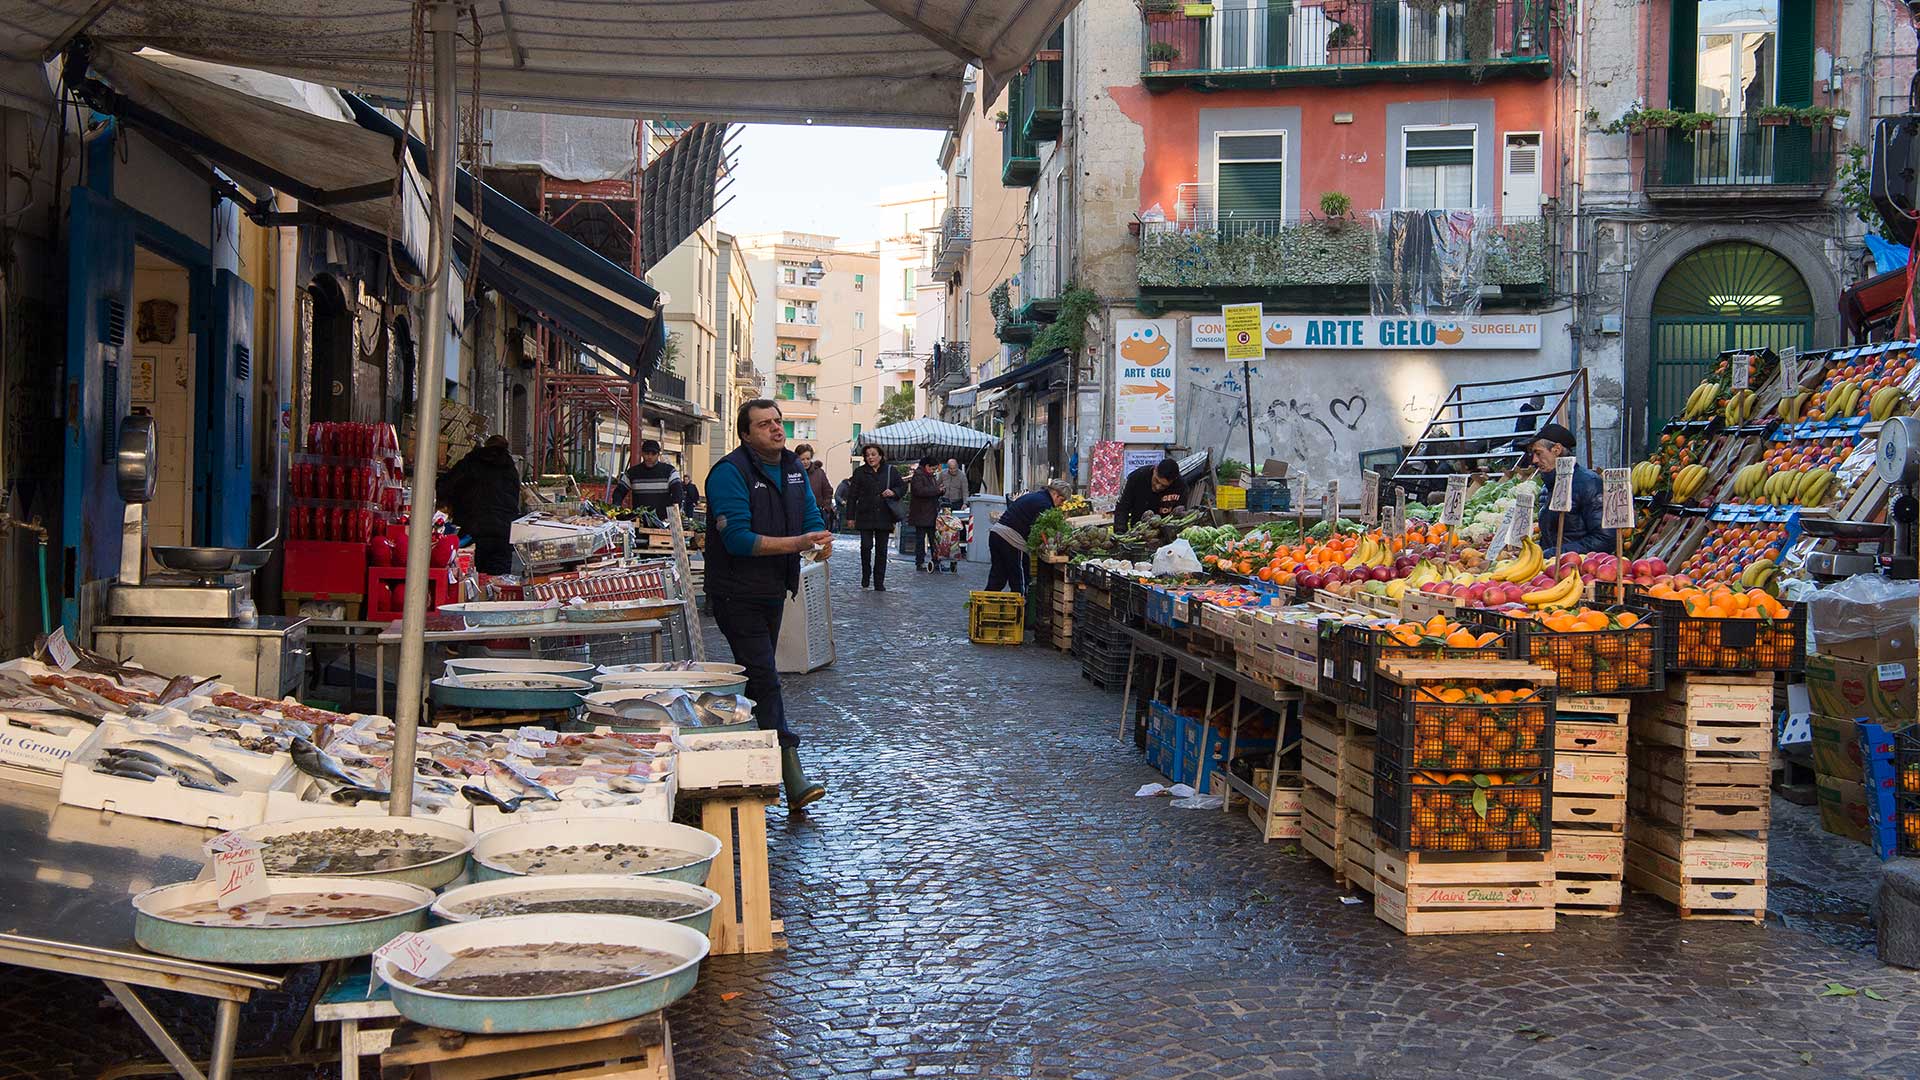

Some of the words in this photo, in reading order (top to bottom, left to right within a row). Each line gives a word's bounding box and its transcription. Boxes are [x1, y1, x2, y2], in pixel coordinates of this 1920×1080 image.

[1197, 324, 1224, 334] CON
[1305, 320, 1363, 346] ARTE
[1379, 320, 1437, 346] GELO
[1471, 323, 1537, 334] SURGELATI
[1124, 367, 1146, 378] ARTE
[1150, 367, 1171, 378] GELO
[18, 738, 71, 759] Group
[1426, 888, 1465, 903] Maini
[1467, 888, 1505, 901] Frutta
